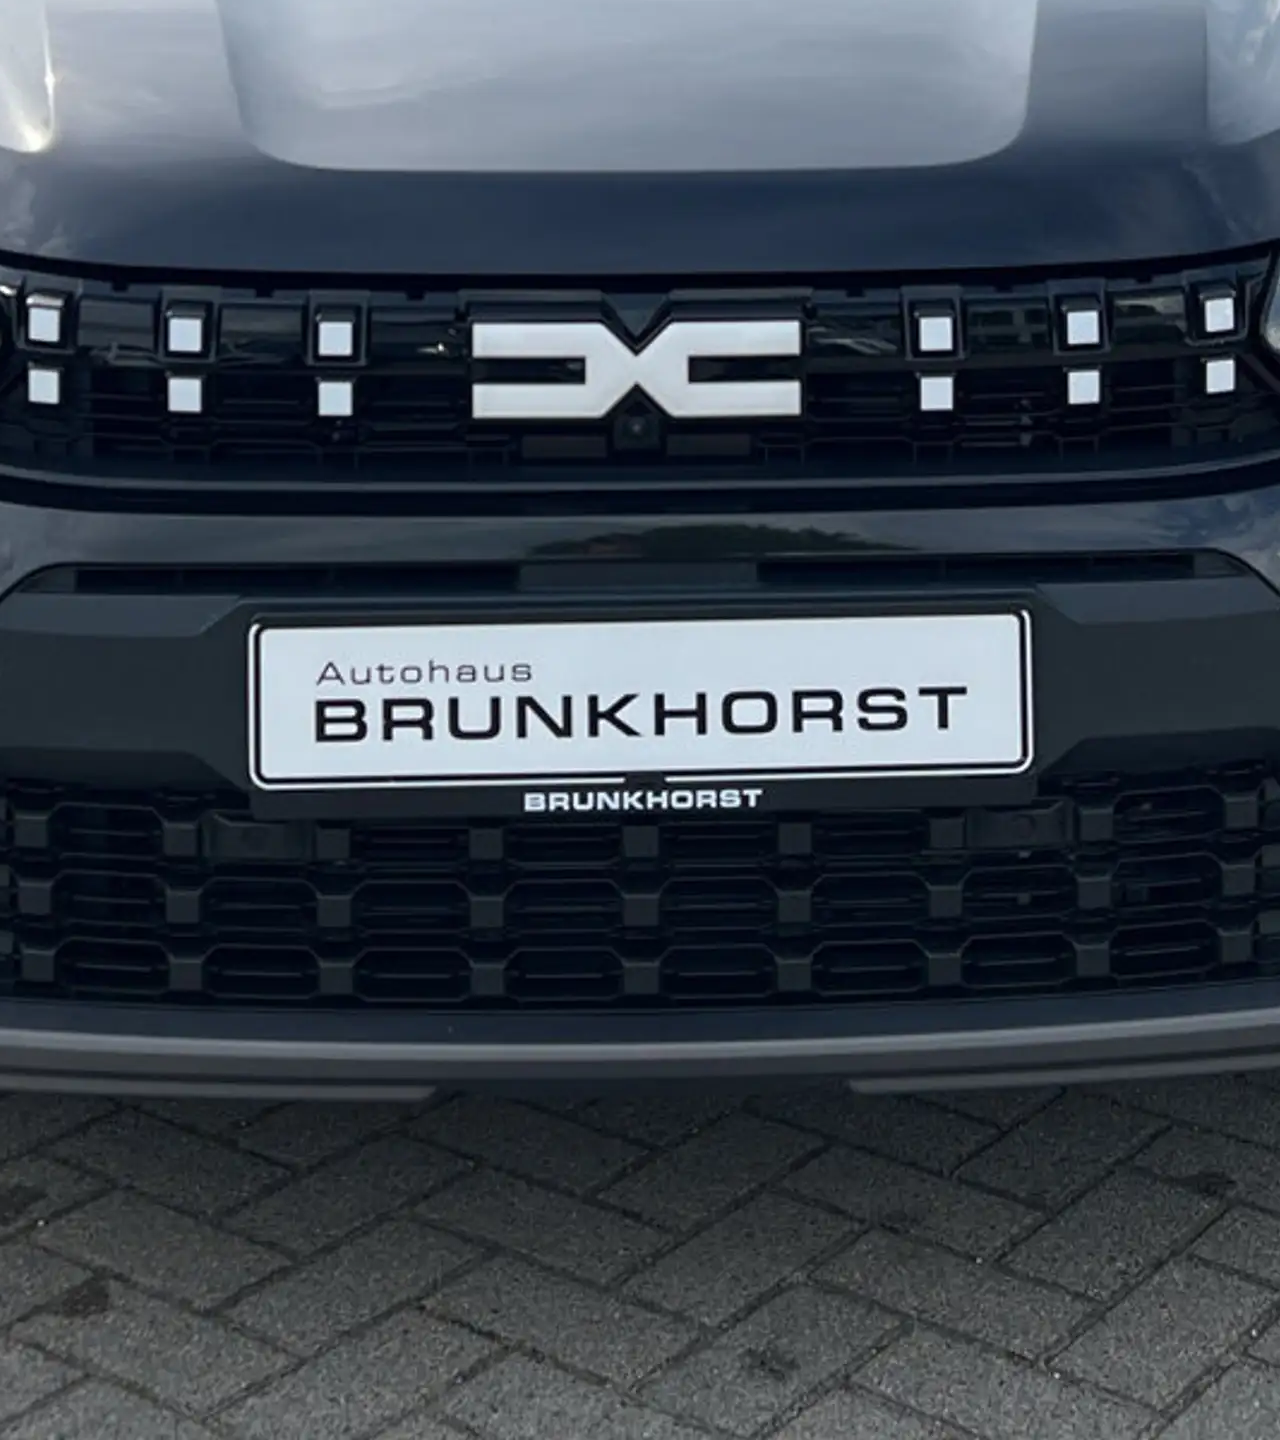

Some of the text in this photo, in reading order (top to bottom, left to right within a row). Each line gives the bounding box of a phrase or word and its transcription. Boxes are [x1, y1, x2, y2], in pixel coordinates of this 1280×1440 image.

[315, 659, 533, 686] Autohaus
[315, 686, 968, 743] BRUNKHORST
[523, 789, 763, 813] BRUNKHORST
